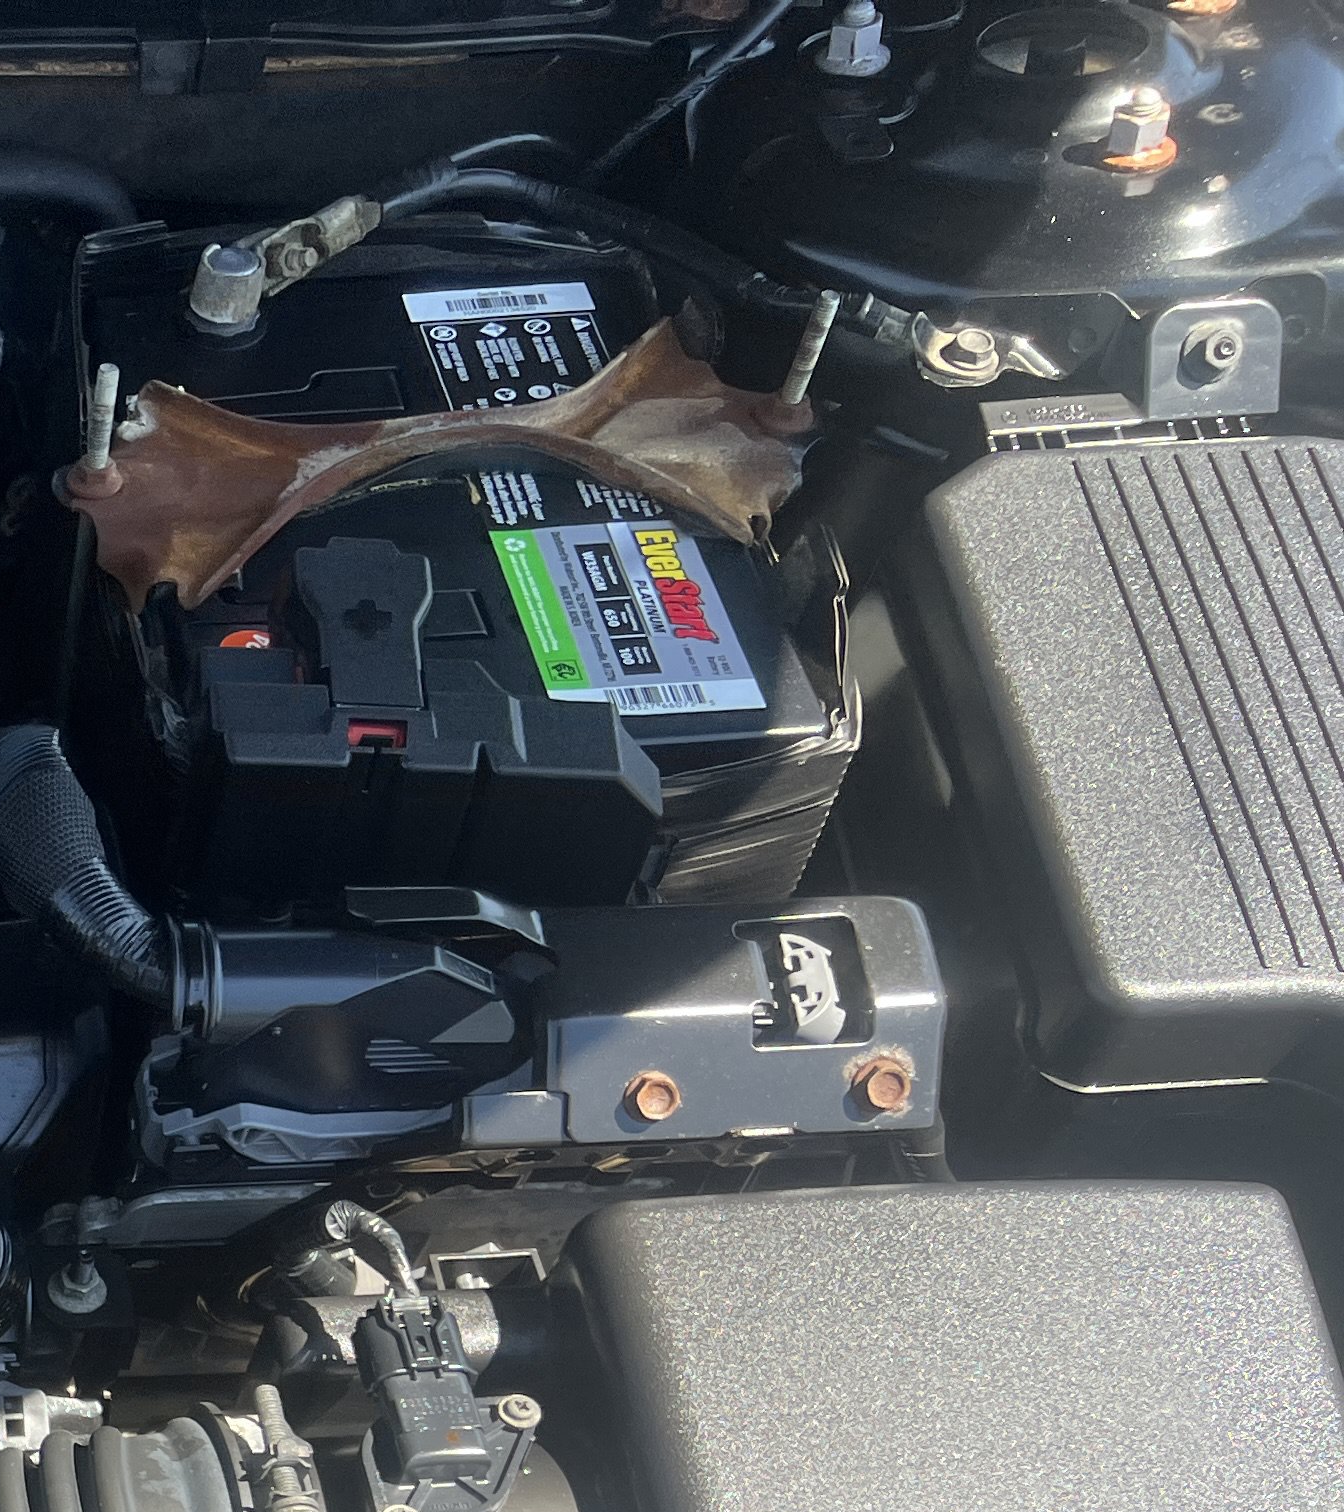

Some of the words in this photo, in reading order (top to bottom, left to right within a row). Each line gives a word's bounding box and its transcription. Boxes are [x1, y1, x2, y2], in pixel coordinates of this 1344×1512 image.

[634, 529, 720, 644] EverStart
[602, 608, 622, 628] 650
[633, 579, 666, 634] PLATINUM
[618, 647, 635, 666] 100
